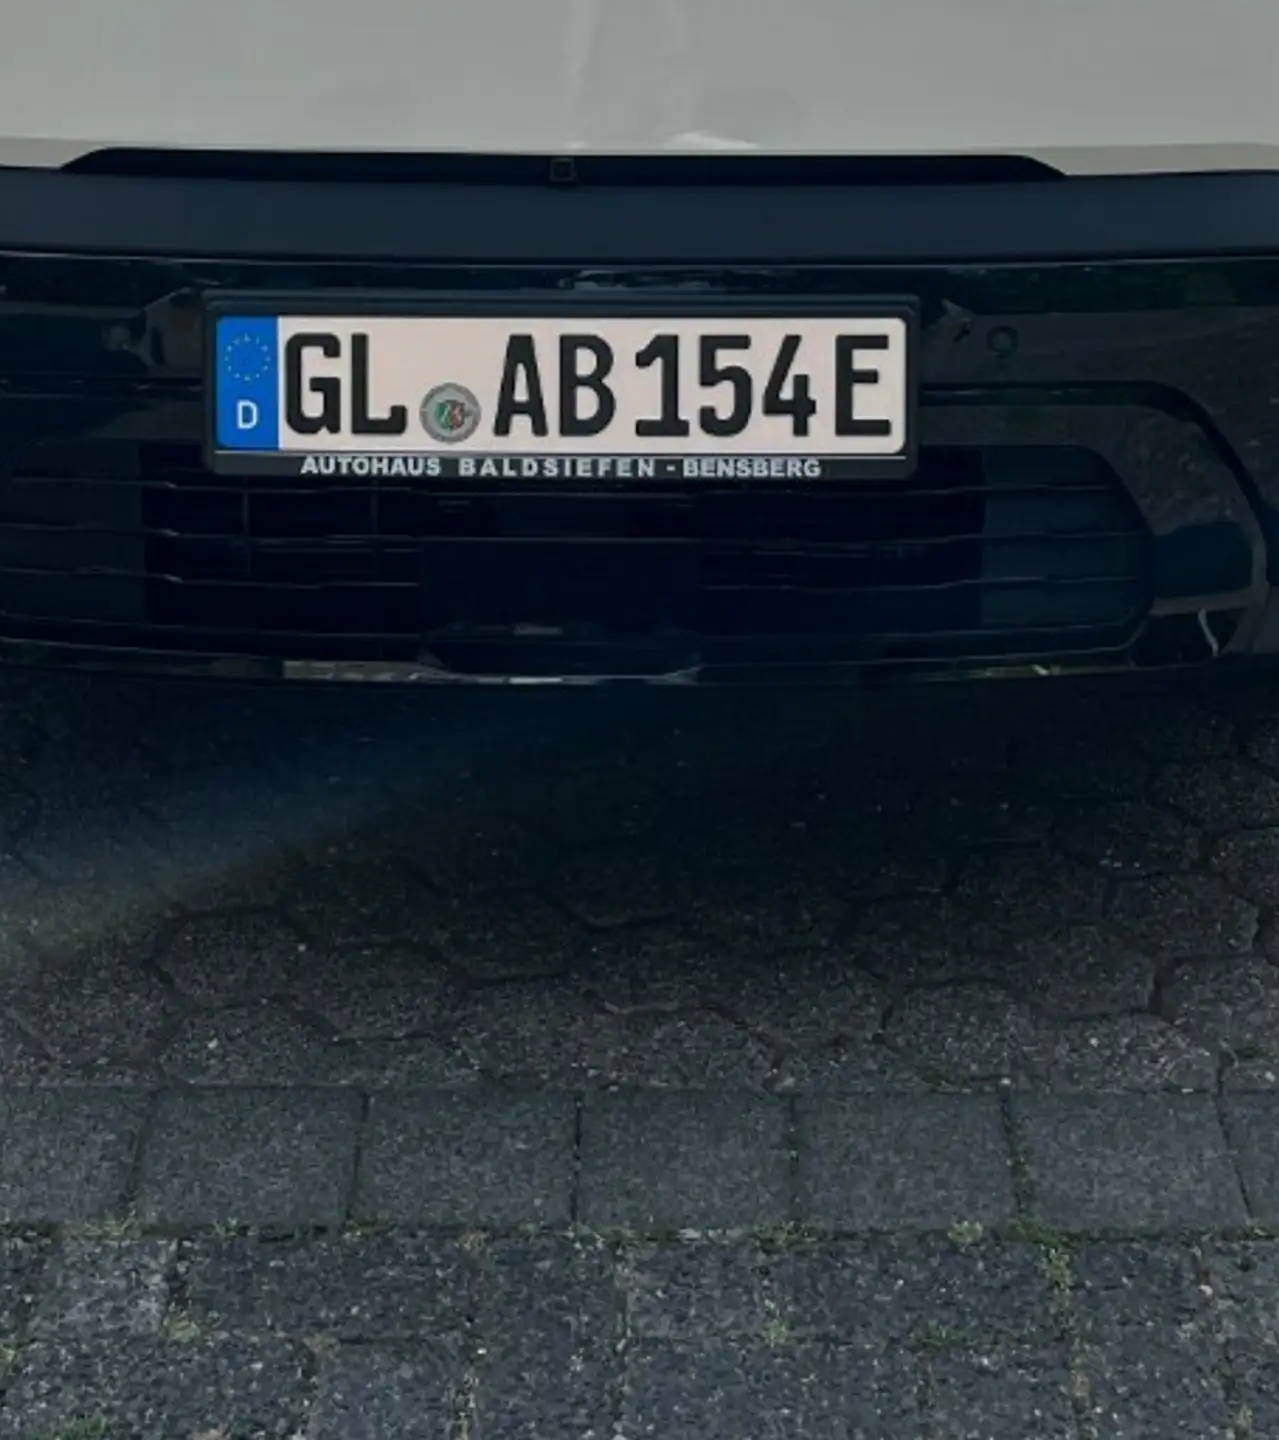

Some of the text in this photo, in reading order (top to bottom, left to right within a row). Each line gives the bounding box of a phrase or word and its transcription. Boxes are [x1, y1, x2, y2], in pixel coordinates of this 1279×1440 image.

[236, 399, 259, 429] D
[285, 332, 409, 435] GL
[300, 456, 441, 476] AUTOHAUS
[458, 458, 655, 477] BALDSIEFEN
[683, 459, 821, 477] BENSBERG
